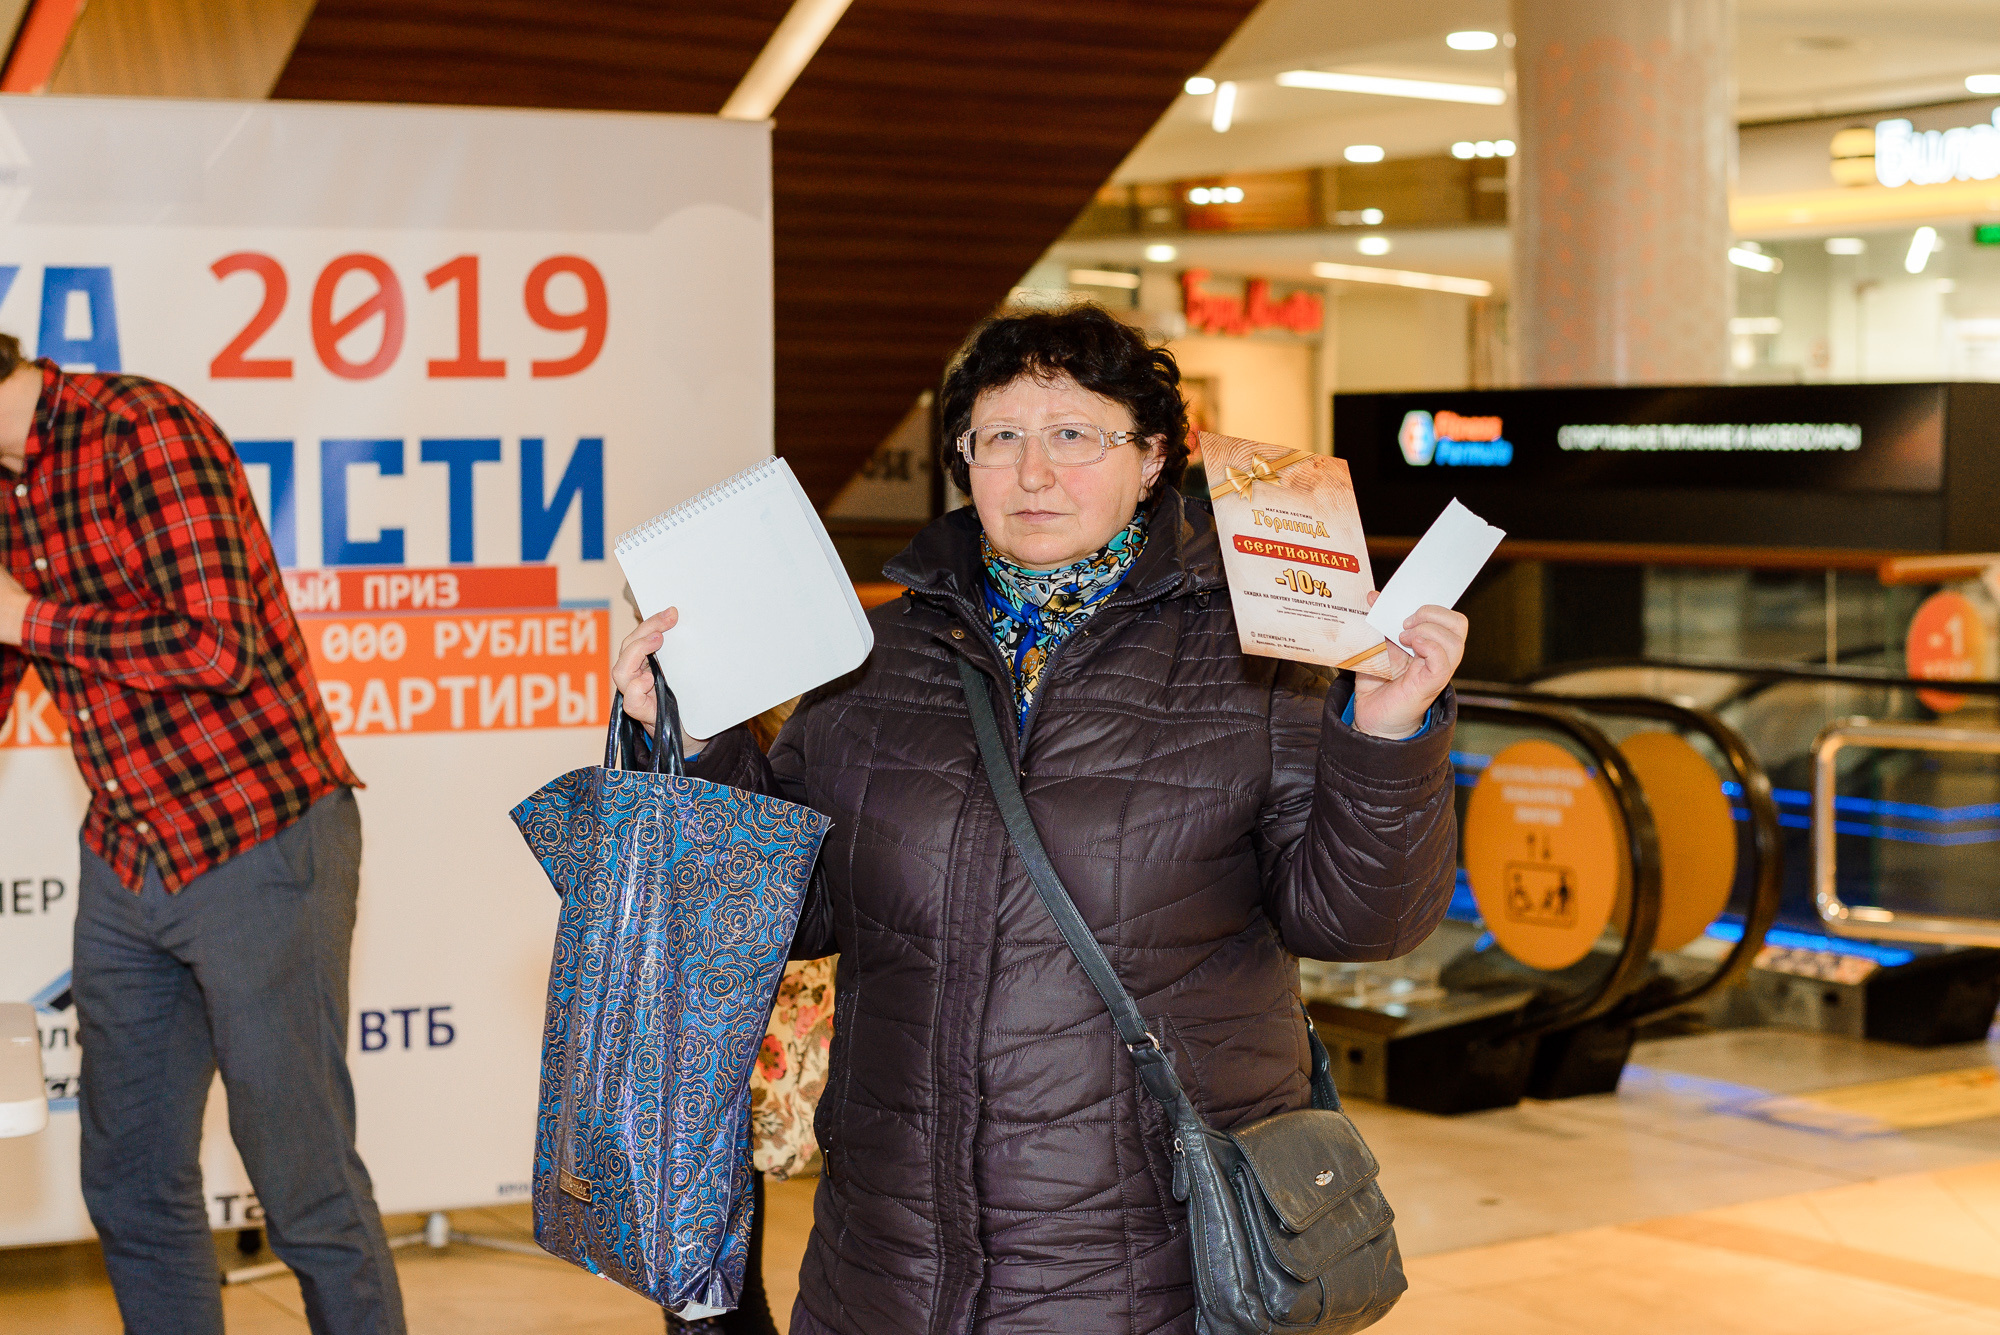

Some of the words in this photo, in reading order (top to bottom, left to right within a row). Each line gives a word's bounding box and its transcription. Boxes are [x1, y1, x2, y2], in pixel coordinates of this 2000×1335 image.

[208, 251, 610, 381] 2019
[1243, 539, 1350, 569] СЕРТИФИКАТ
[363, 572, 460, 609] ПРИЗ
[1243, 590, 1262, 598] СКИДКА
[1275, 568, 1333, 598] -10%
[321, 621, 407, 663] 000
[434, 611, 598, 659] РУБЛЕЙ
[361, 1006, 456, 1051] ВТБ
